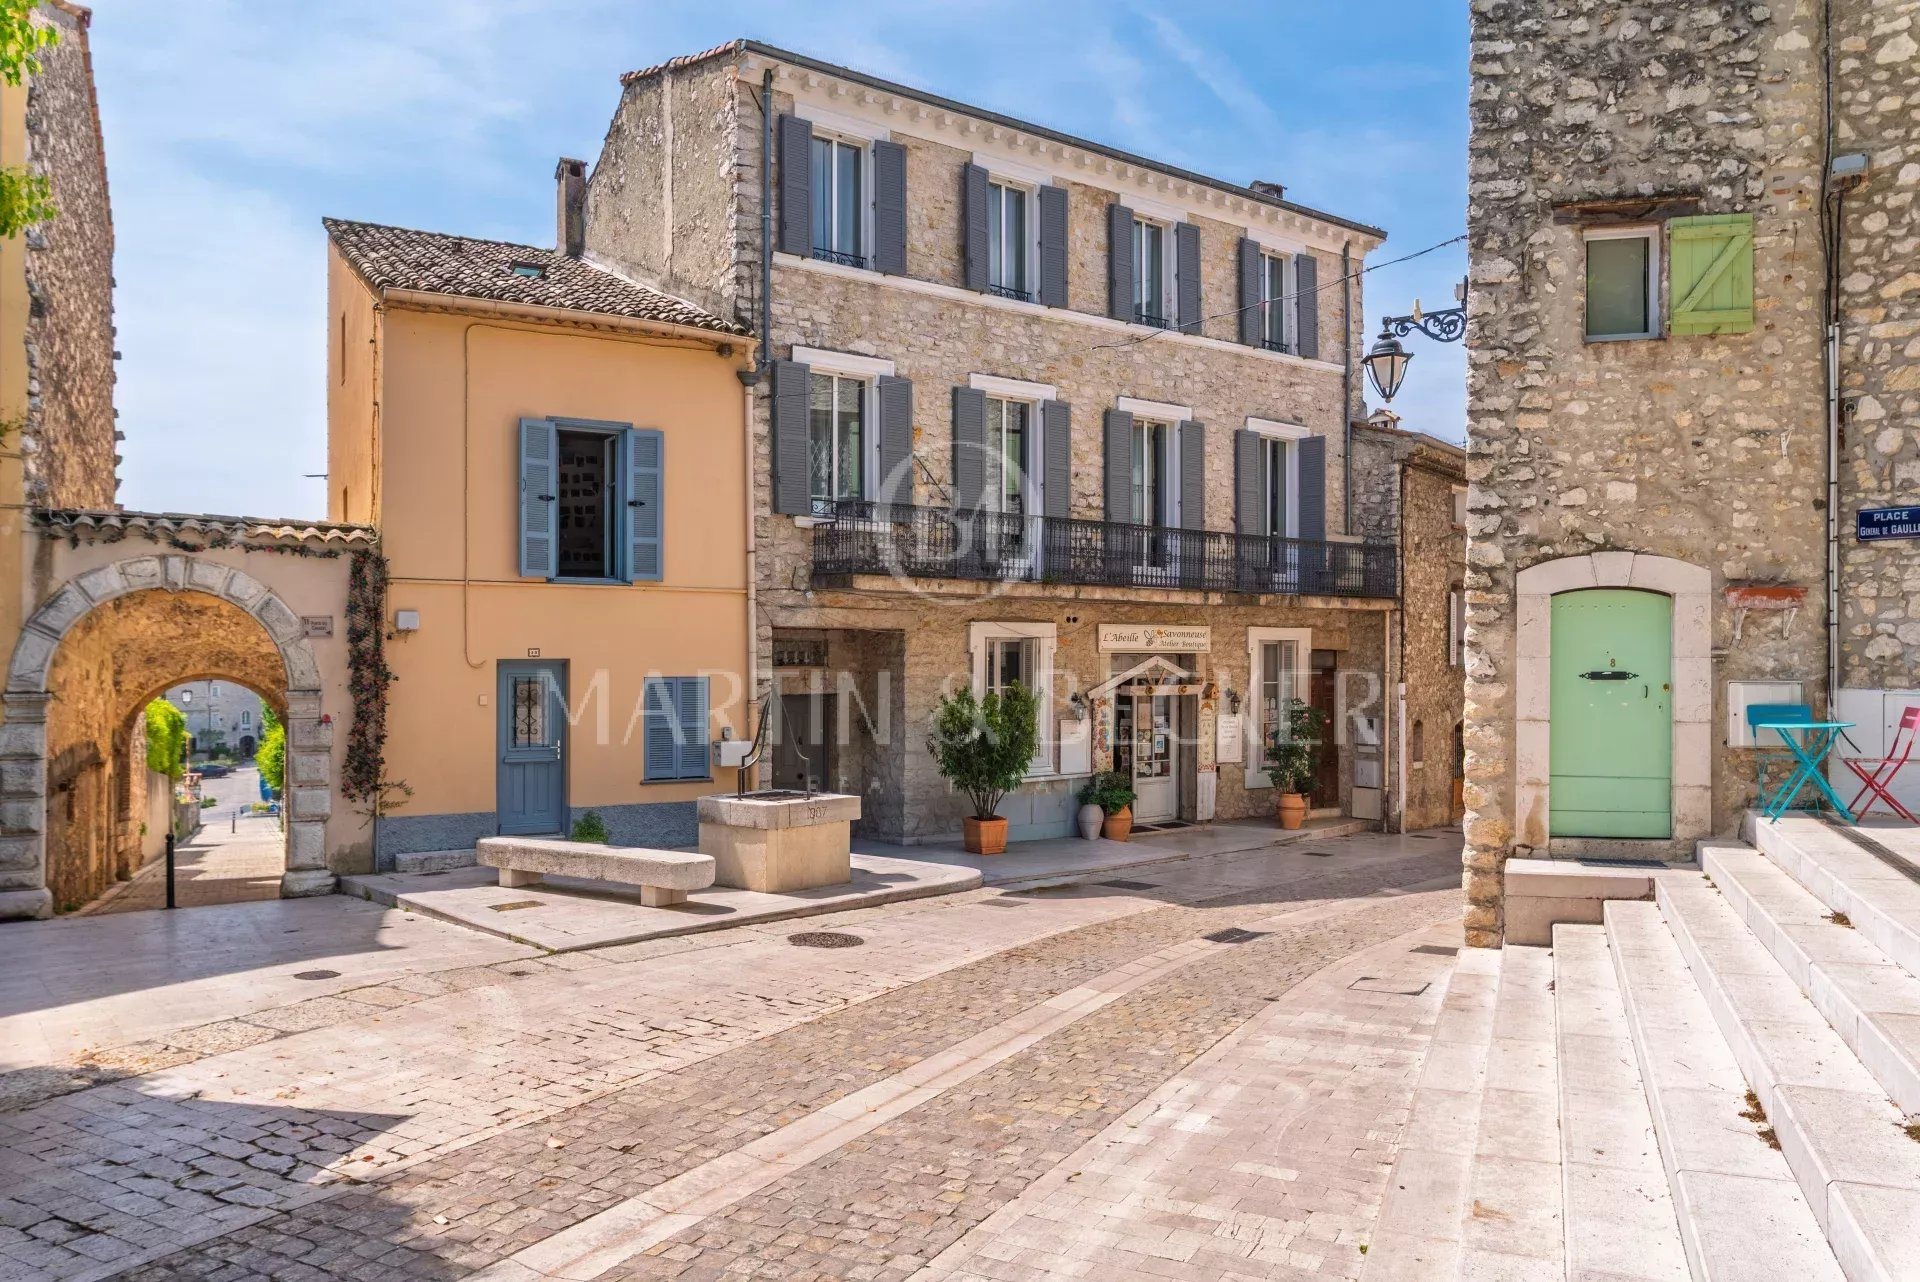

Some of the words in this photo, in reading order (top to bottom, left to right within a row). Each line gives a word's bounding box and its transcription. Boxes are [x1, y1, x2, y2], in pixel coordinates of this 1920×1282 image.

[1873, 511, 1909, 522] PLACE
[1103, 632, 1139, 643] L'Abeille
[1162, 629, 1207, 639] Savonneuse
[1610, 658, 1616, 668] 8
